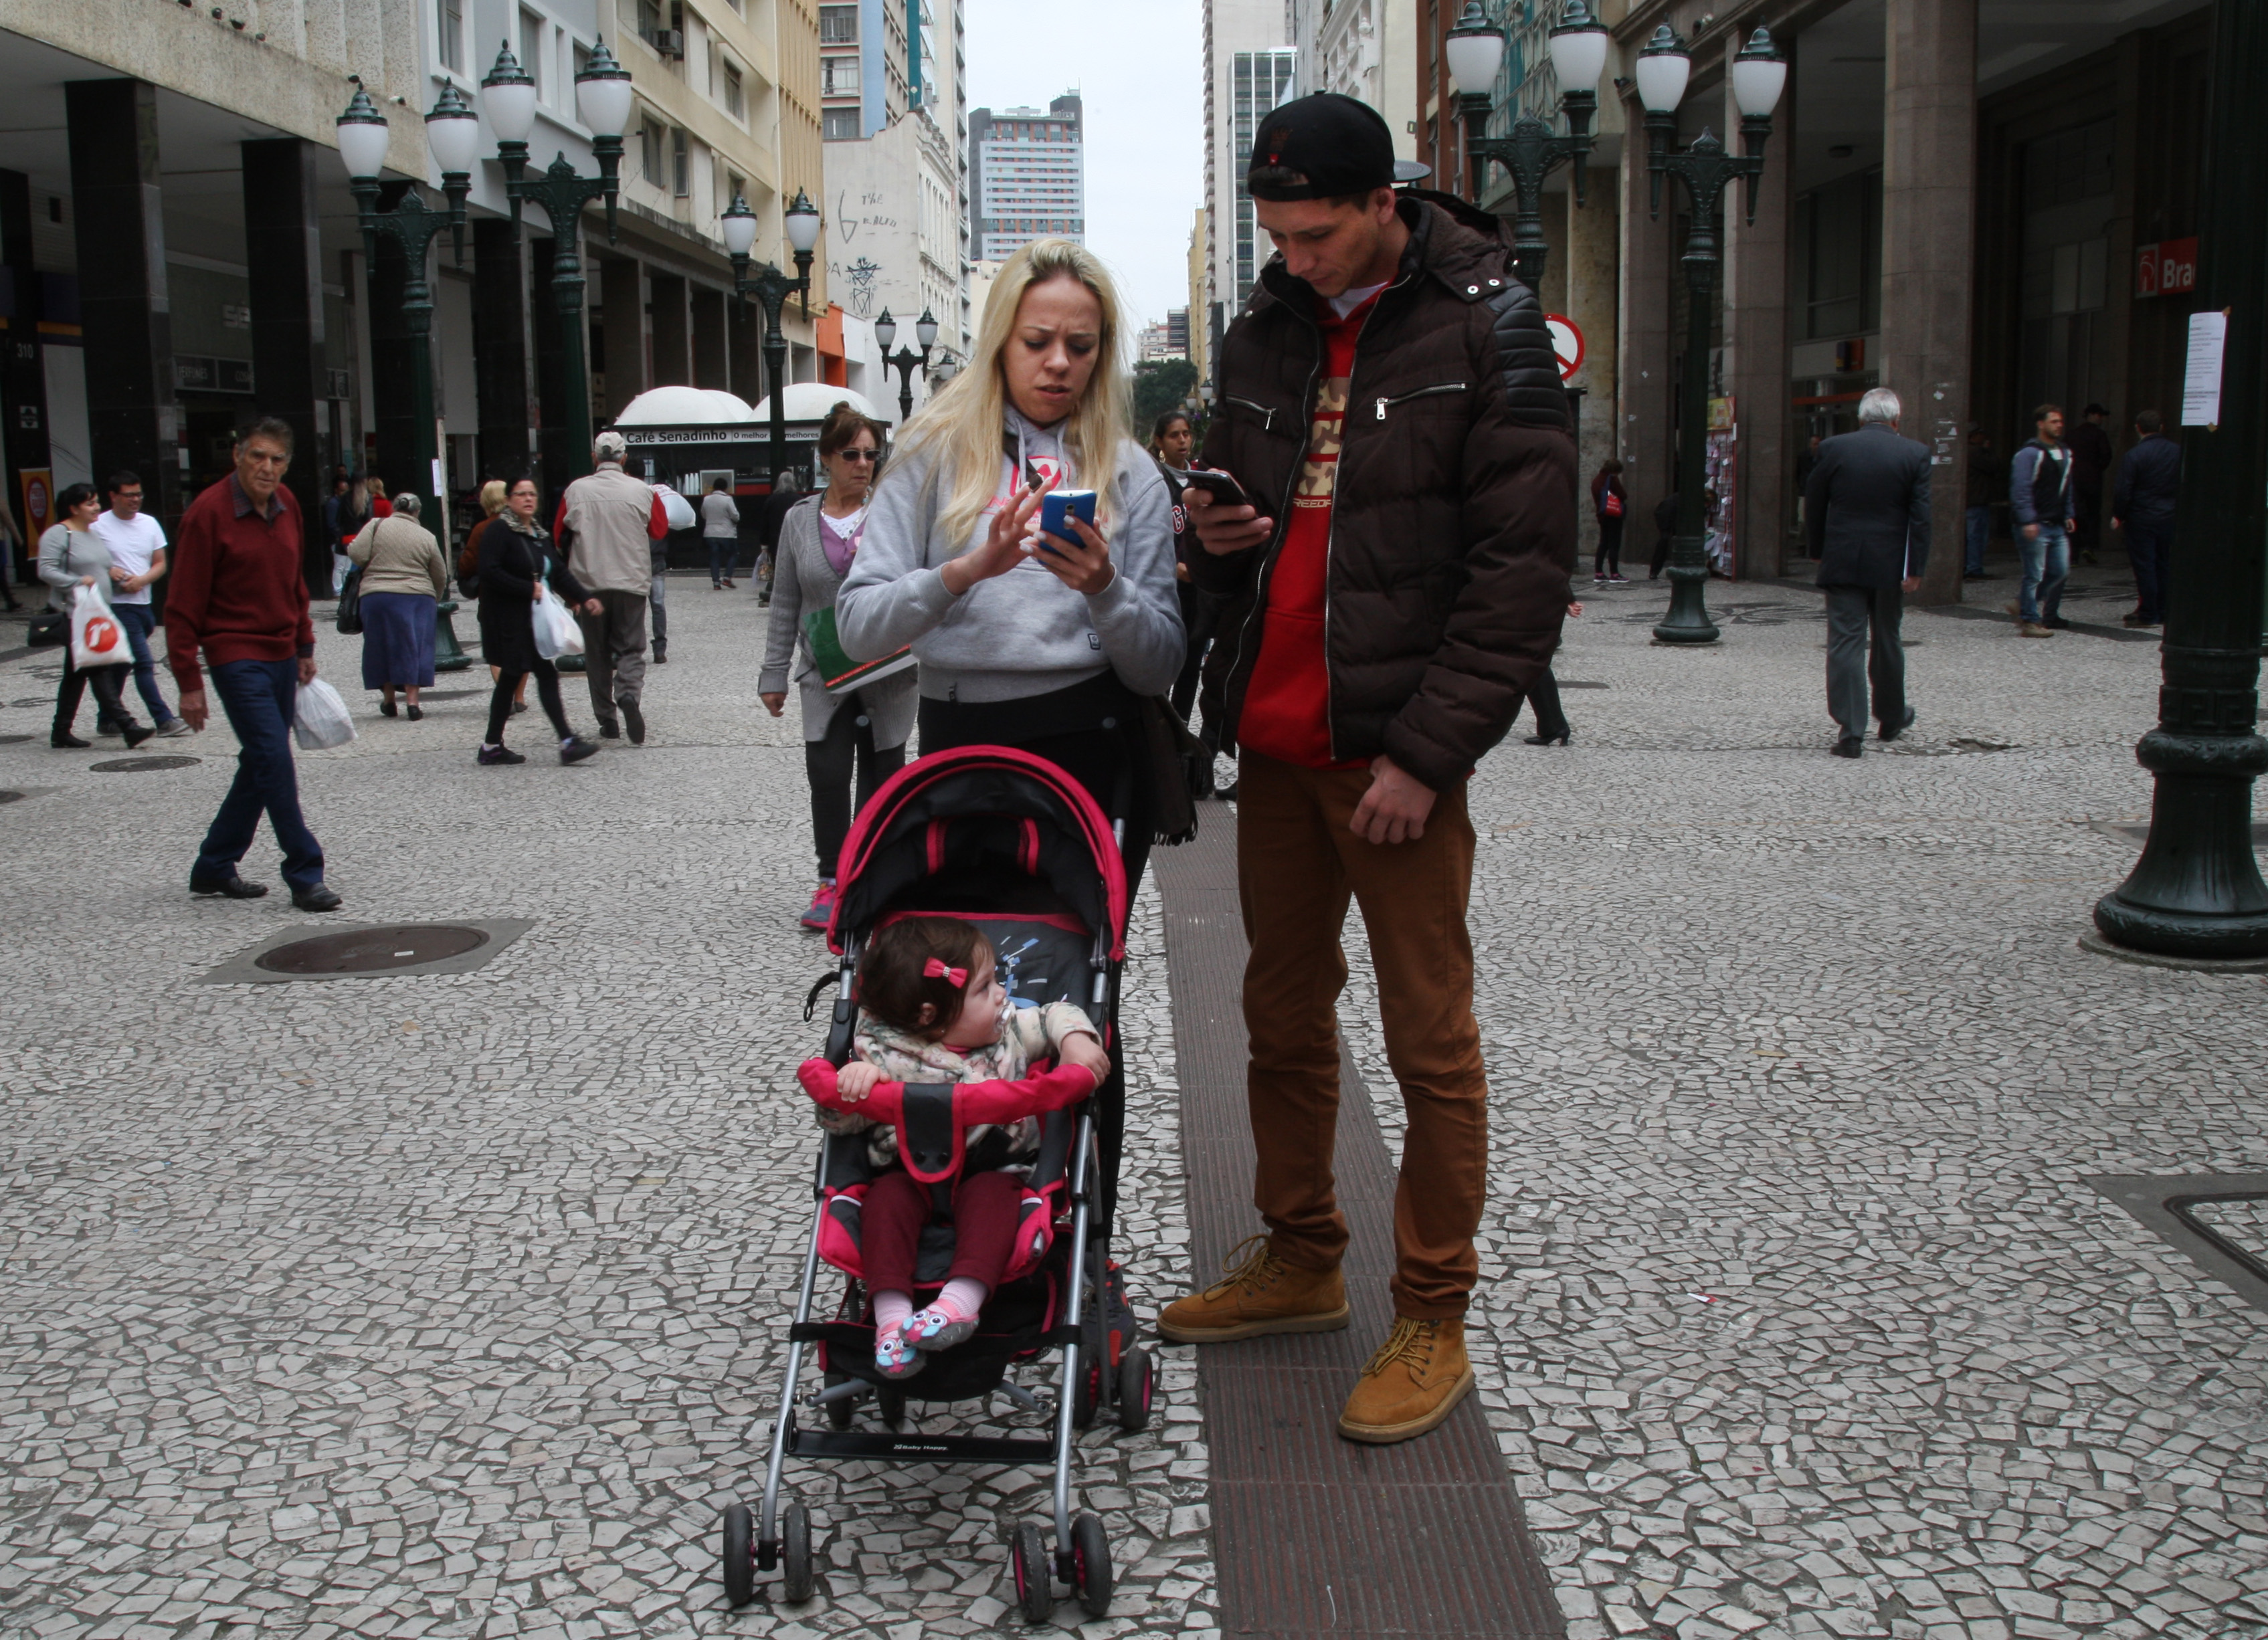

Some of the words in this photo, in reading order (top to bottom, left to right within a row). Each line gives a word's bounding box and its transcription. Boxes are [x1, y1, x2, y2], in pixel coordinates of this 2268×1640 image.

[2163, 259, 2195, 288] Bra
[17, 342, 33, 359] 310
[626, 431, 655, 443] Café
[659, 429, 727, 442] Senadinho
